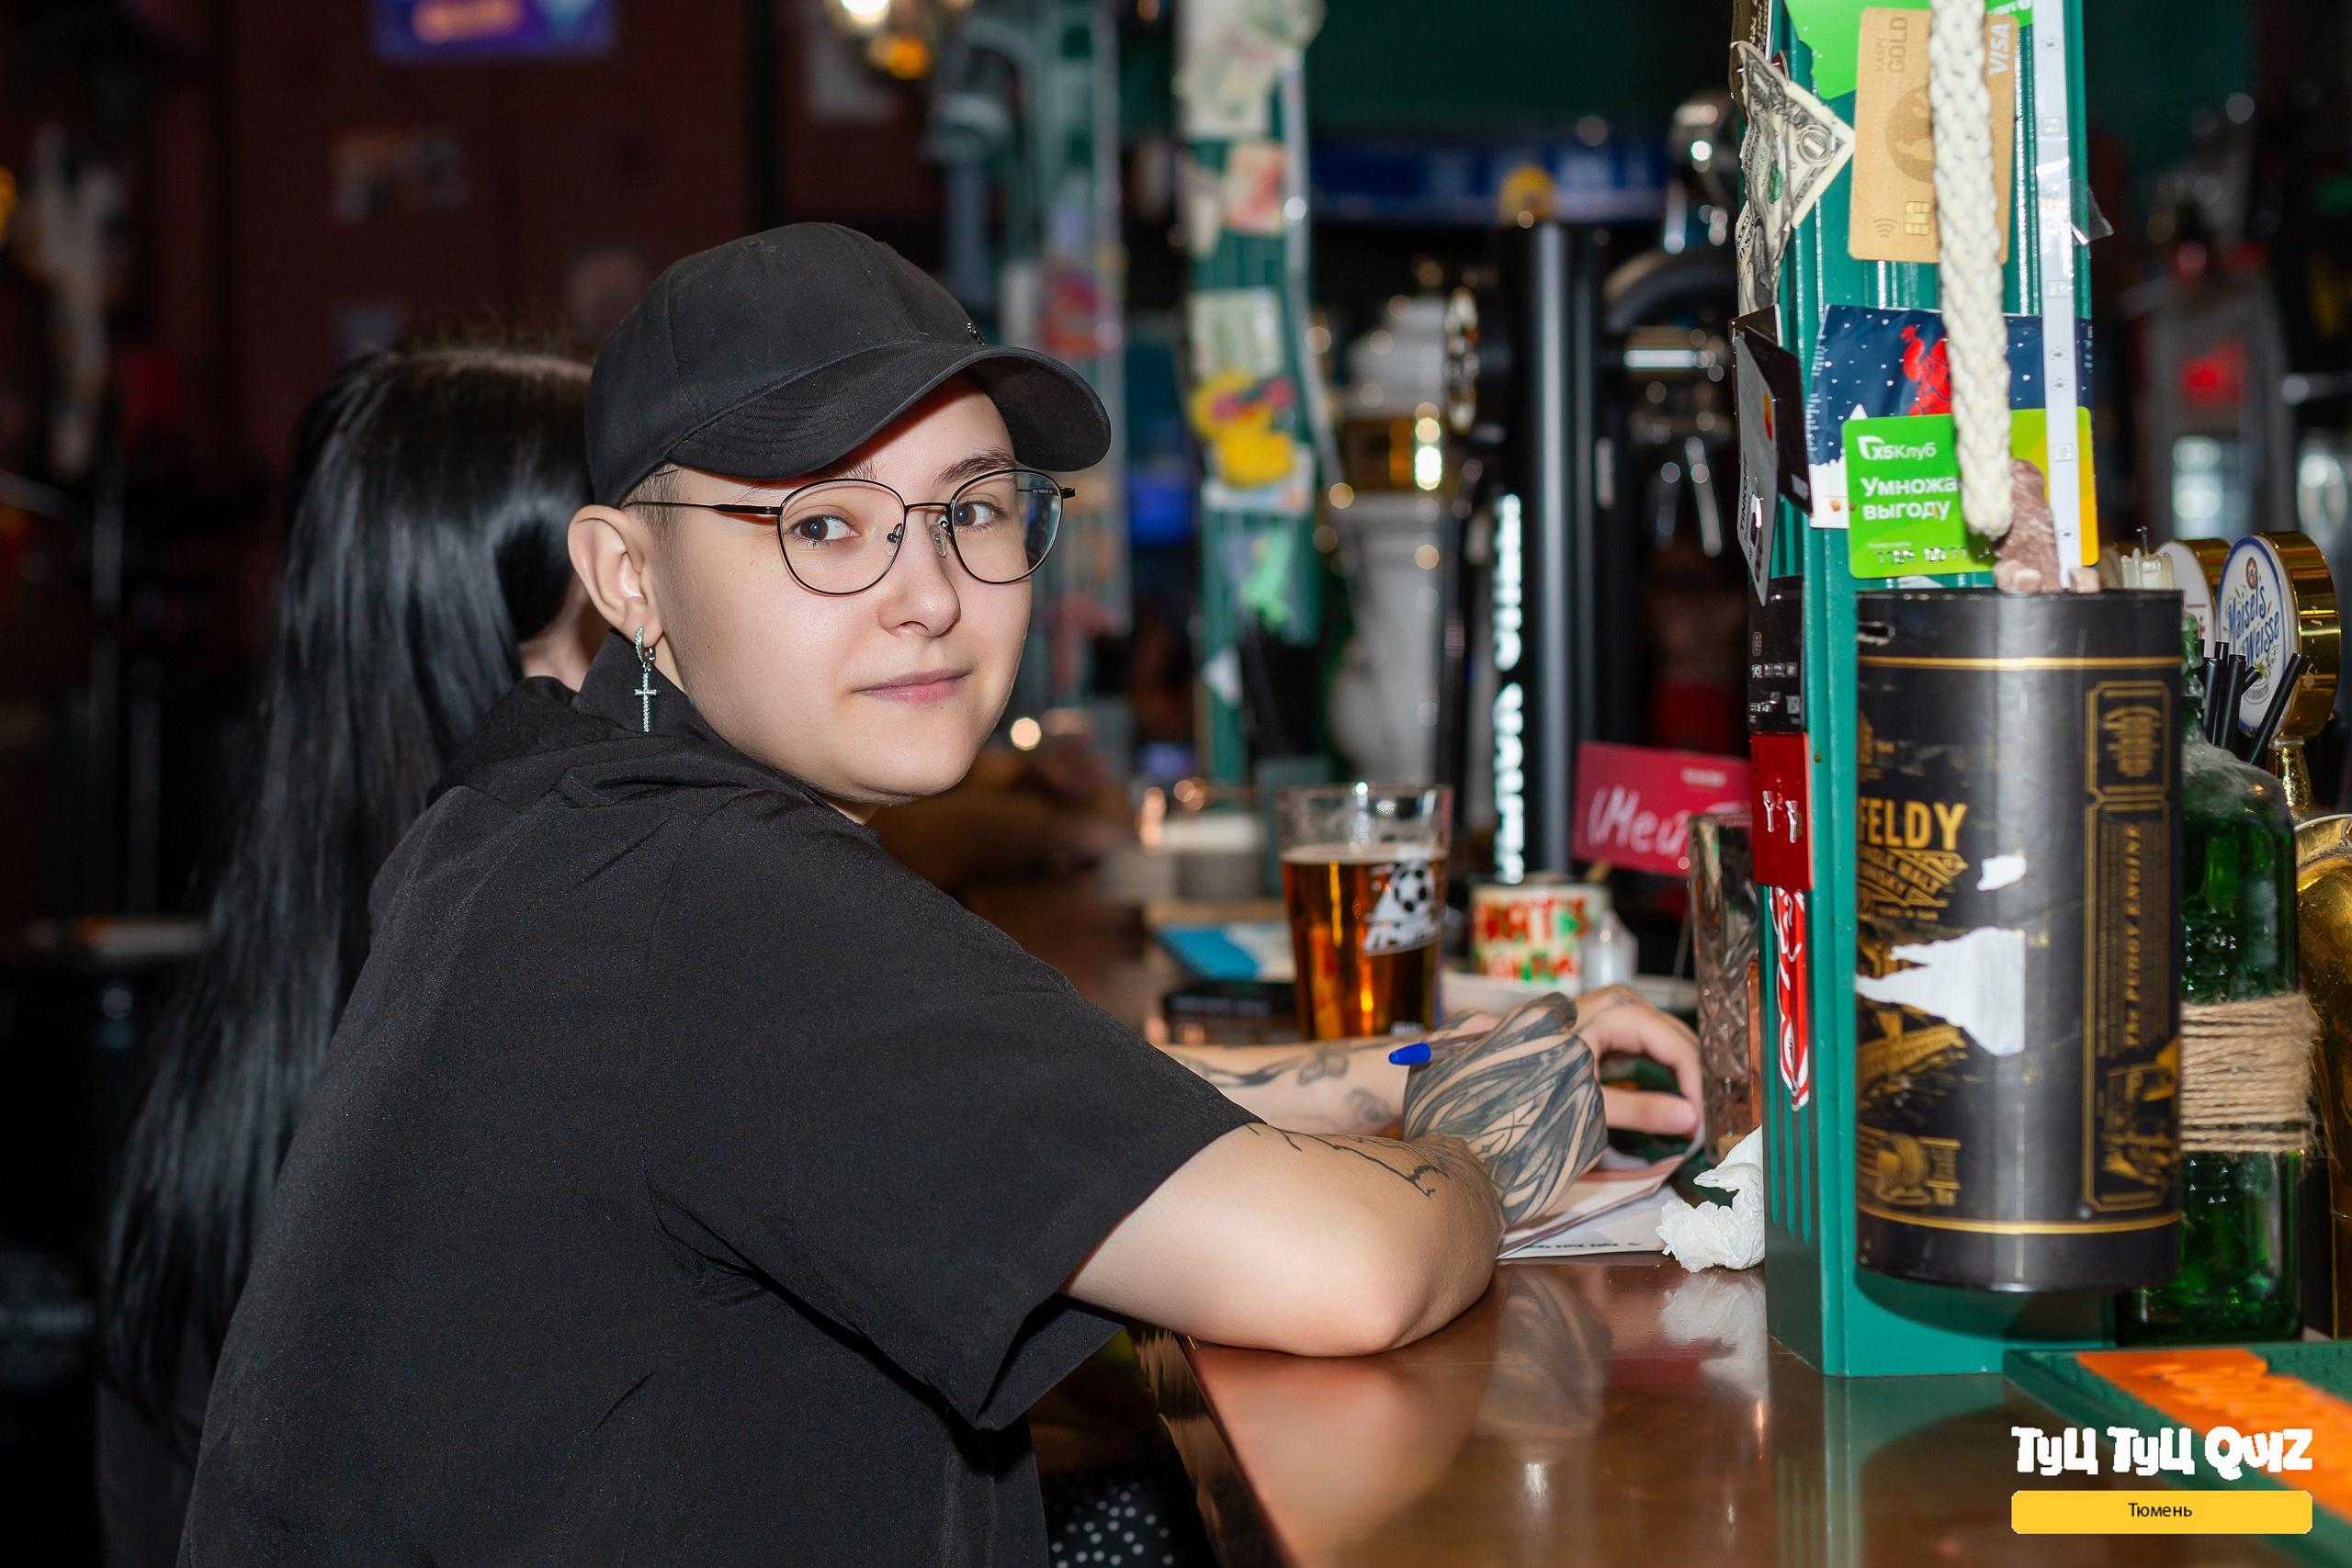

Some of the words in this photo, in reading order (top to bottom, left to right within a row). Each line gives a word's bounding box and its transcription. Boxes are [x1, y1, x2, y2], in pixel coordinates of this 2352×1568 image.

[1887, 16, 1908, 73] GOLD
[1987, 21, 2011, 77] VISA
[1860, 476, 1959, 498] Умножа
[1862, 501, 1951, 521] выгоду
[2242, 611, 2280, 671] Weisse
